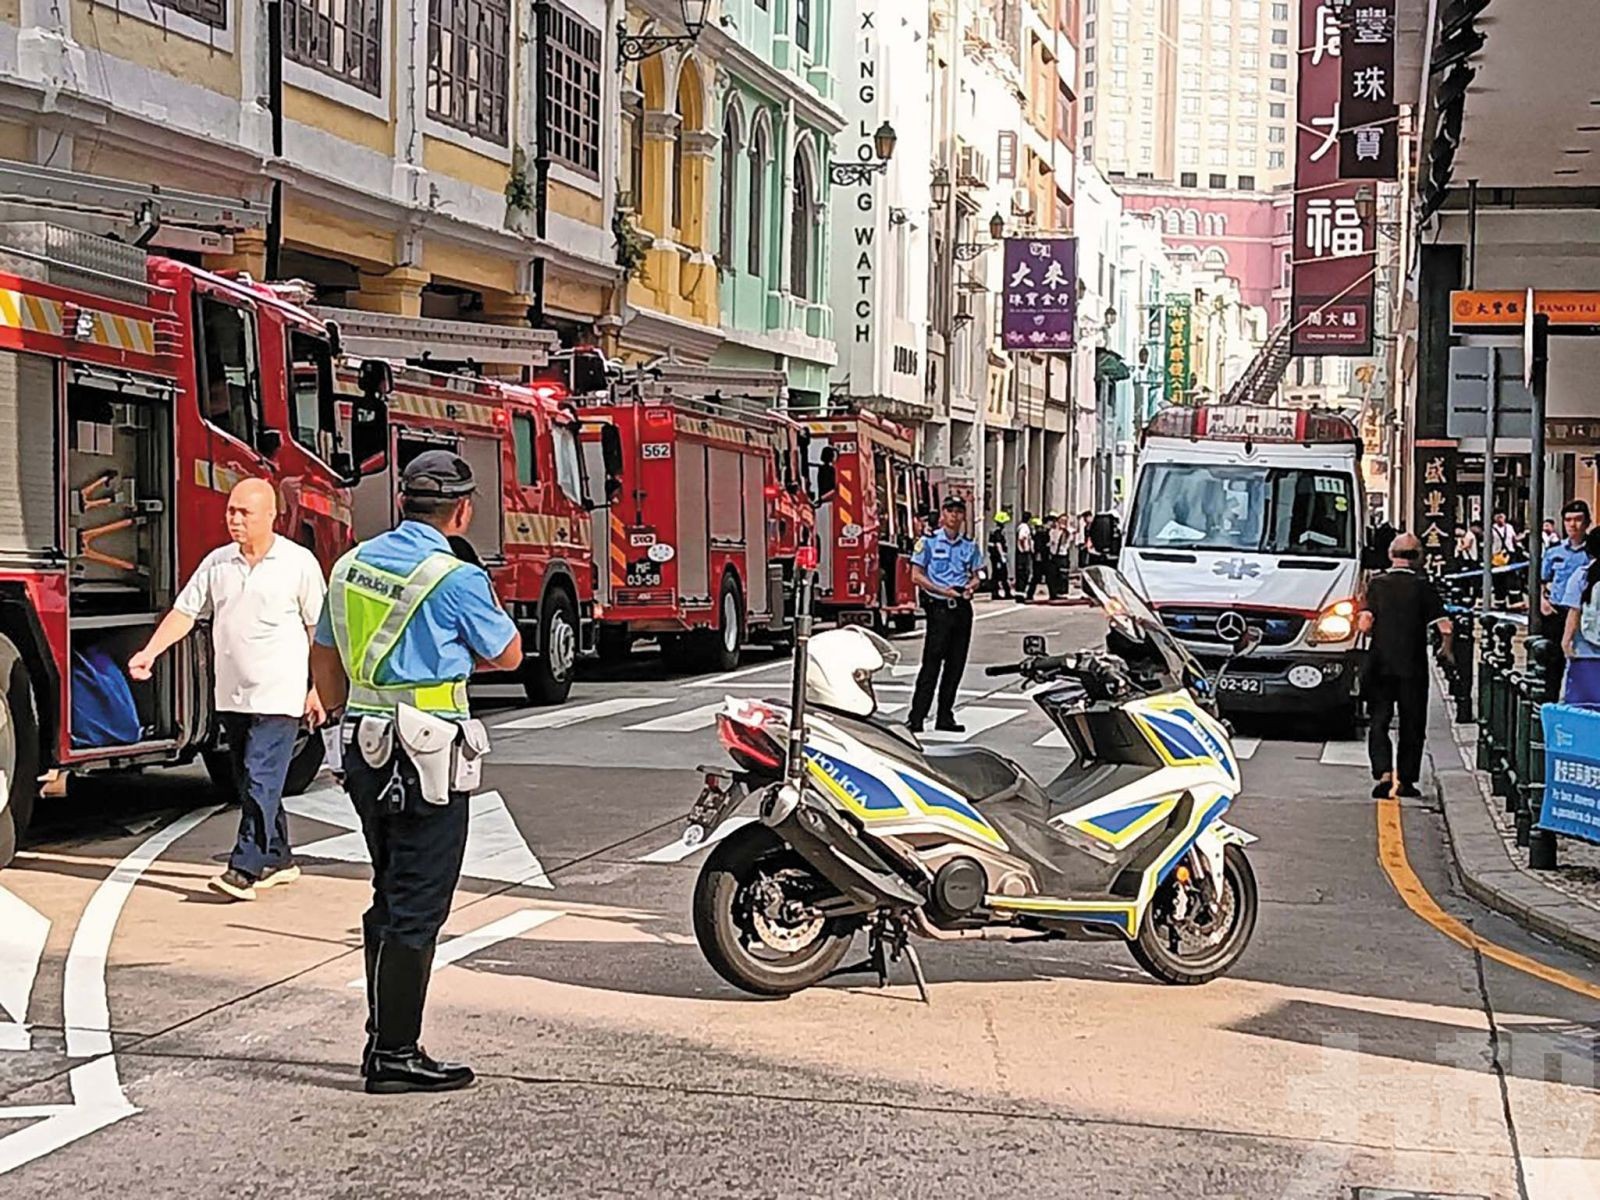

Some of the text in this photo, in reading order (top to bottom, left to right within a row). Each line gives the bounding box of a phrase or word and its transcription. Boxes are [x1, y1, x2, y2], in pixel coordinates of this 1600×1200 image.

[855, 12, 874, 343] XING LONG WATCH
[644, 445, 670, 457] 562
[1318, 478, 1341, 492] 111
[627, 574, 661, 586] 03-58
[1219, 677, 1258, 692] 02-92
